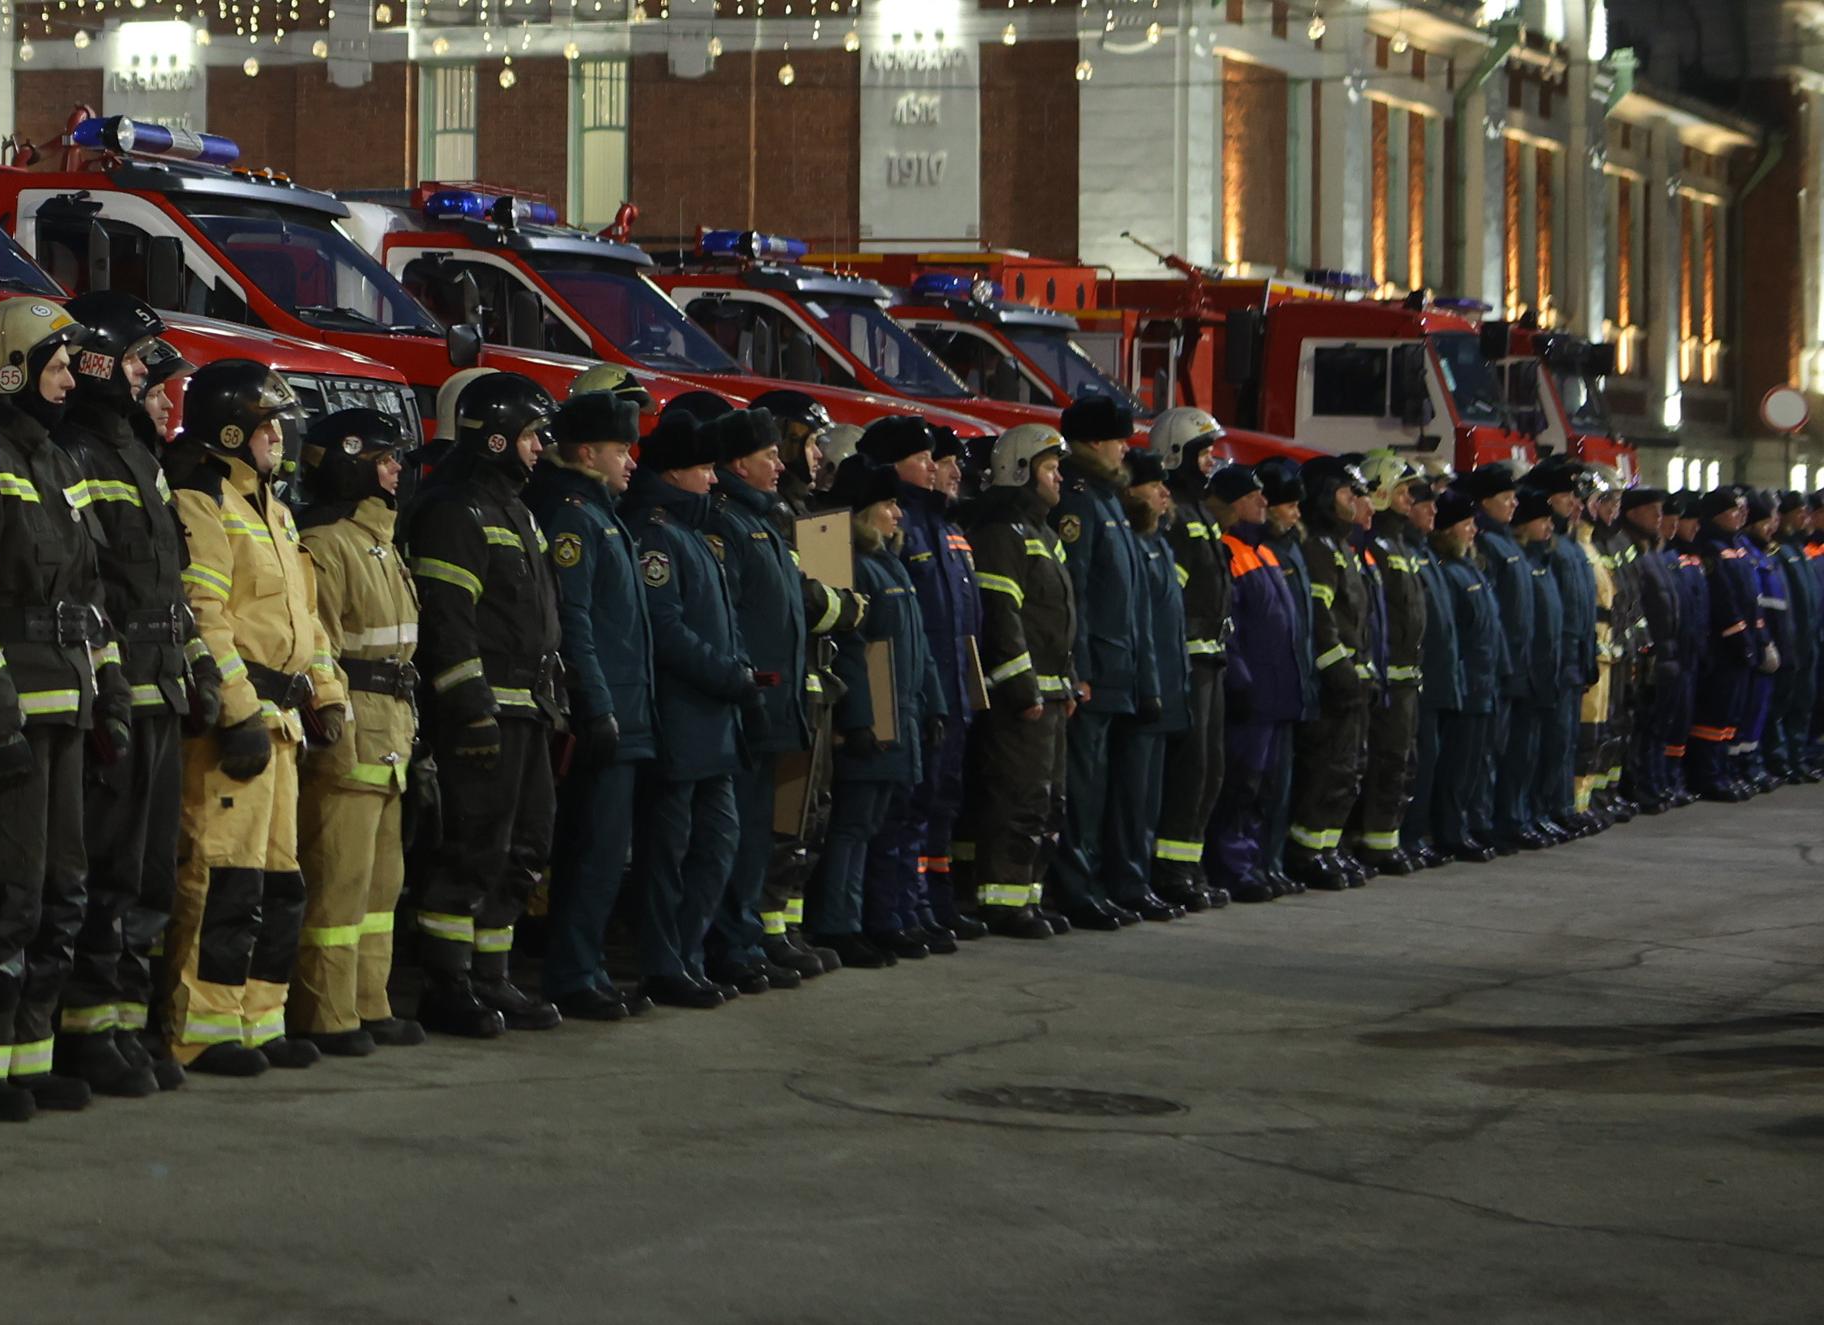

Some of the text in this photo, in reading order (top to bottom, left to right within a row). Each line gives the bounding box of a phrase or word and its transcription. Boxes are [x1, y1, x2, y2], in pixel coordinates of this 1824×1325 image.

[1, 370, 22, 385] 55
[225, 428, 240, 444] 58
[490, 435, 505, 451] 59
